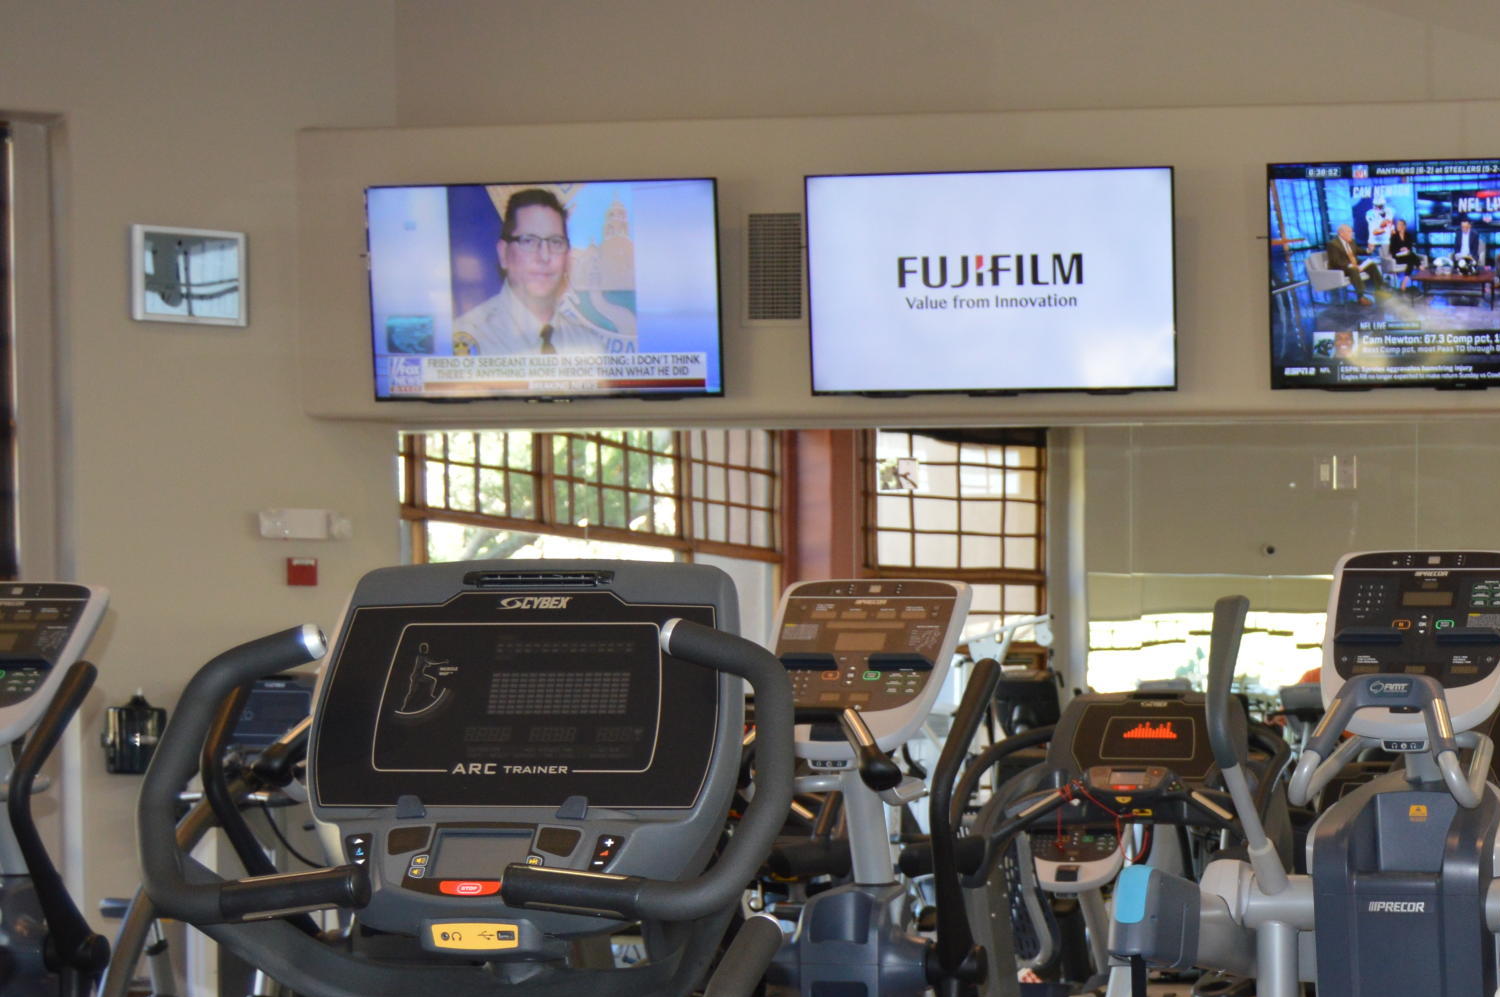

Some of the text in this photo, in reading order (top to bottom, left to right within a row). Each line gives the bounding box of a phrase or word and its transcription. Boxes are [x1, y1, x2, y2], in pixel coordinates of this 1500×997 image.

[1457, 198, 1482, 212] NFL
[897, 252, 1084, 289] FUJIFILM
[905, 293, 1078, 310] Value from Innovation
[1362, 335, 1383, 345] Cam
[1384, 334, 1422, 345] Newton:
[1446, 333, 1473, 345] Comp
[477, 357, 528, 368] SERGEANT
[560, 356, 571, 366] IN
[636, 354, 669, 365] DON'T
[670, 353, 700, 365] THINK
[558, 367, 593, 377] HEROIC
[597, 366, 624, 377] THAN
[625, 366, 655, 376] WHAT
[657, 366, 670, 376] HE
[672, 365, 690, 376] DID
[520, 596, 574, 609] CYBEX
[451, 762, 569, 775] ARC TRAINER
[1375, 900, 1425, 913] PRECOR
